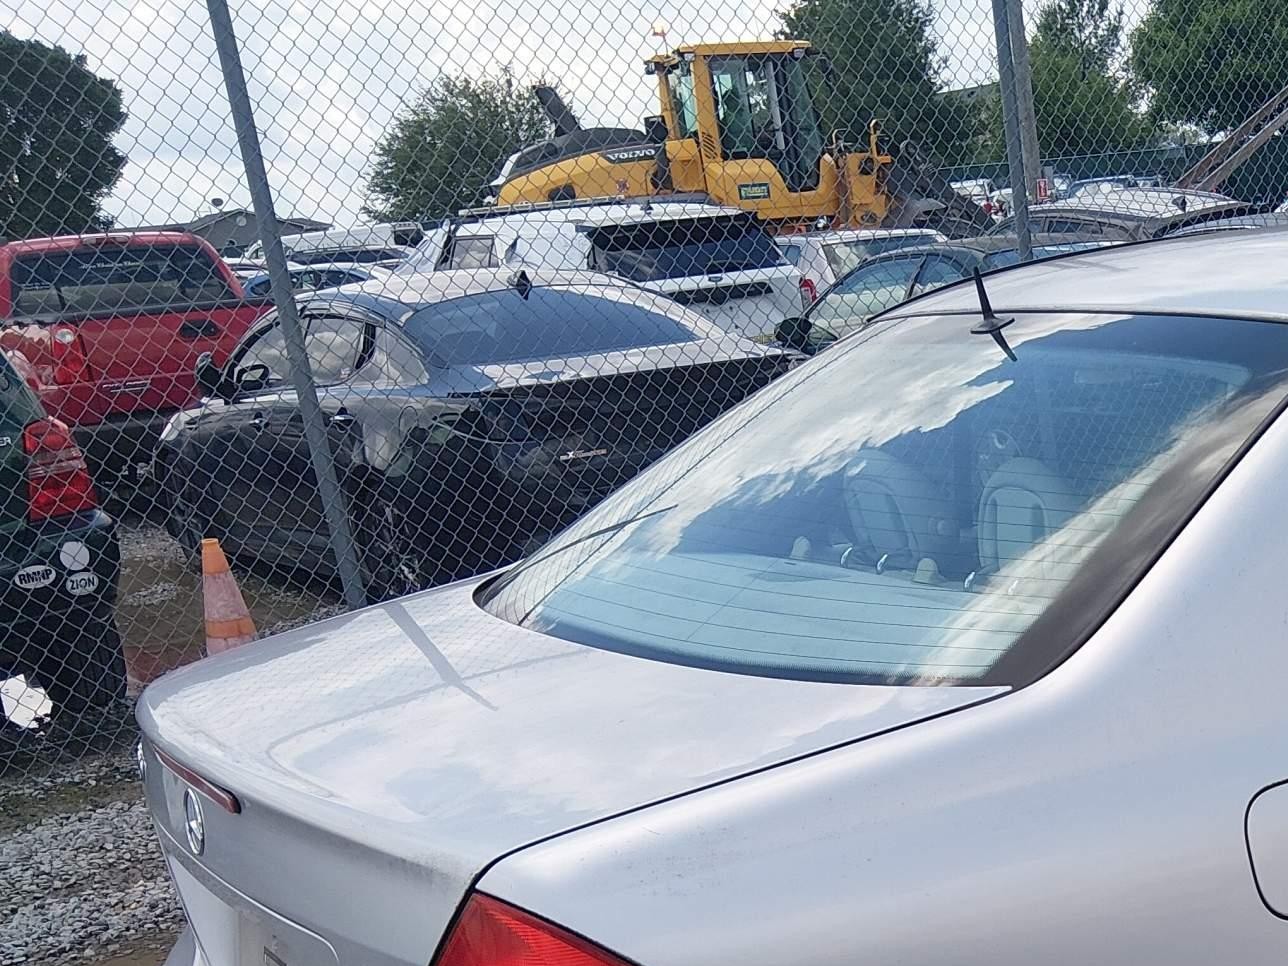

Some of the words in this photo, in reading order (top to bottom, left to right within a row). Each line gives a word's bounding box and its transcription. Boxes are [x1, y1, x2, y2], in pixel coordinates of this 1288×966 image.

[606, 149, 656, 161] VOLVO
[18, 569, 53, 586] RMNP
[69, 576, 96, 591] ZION
